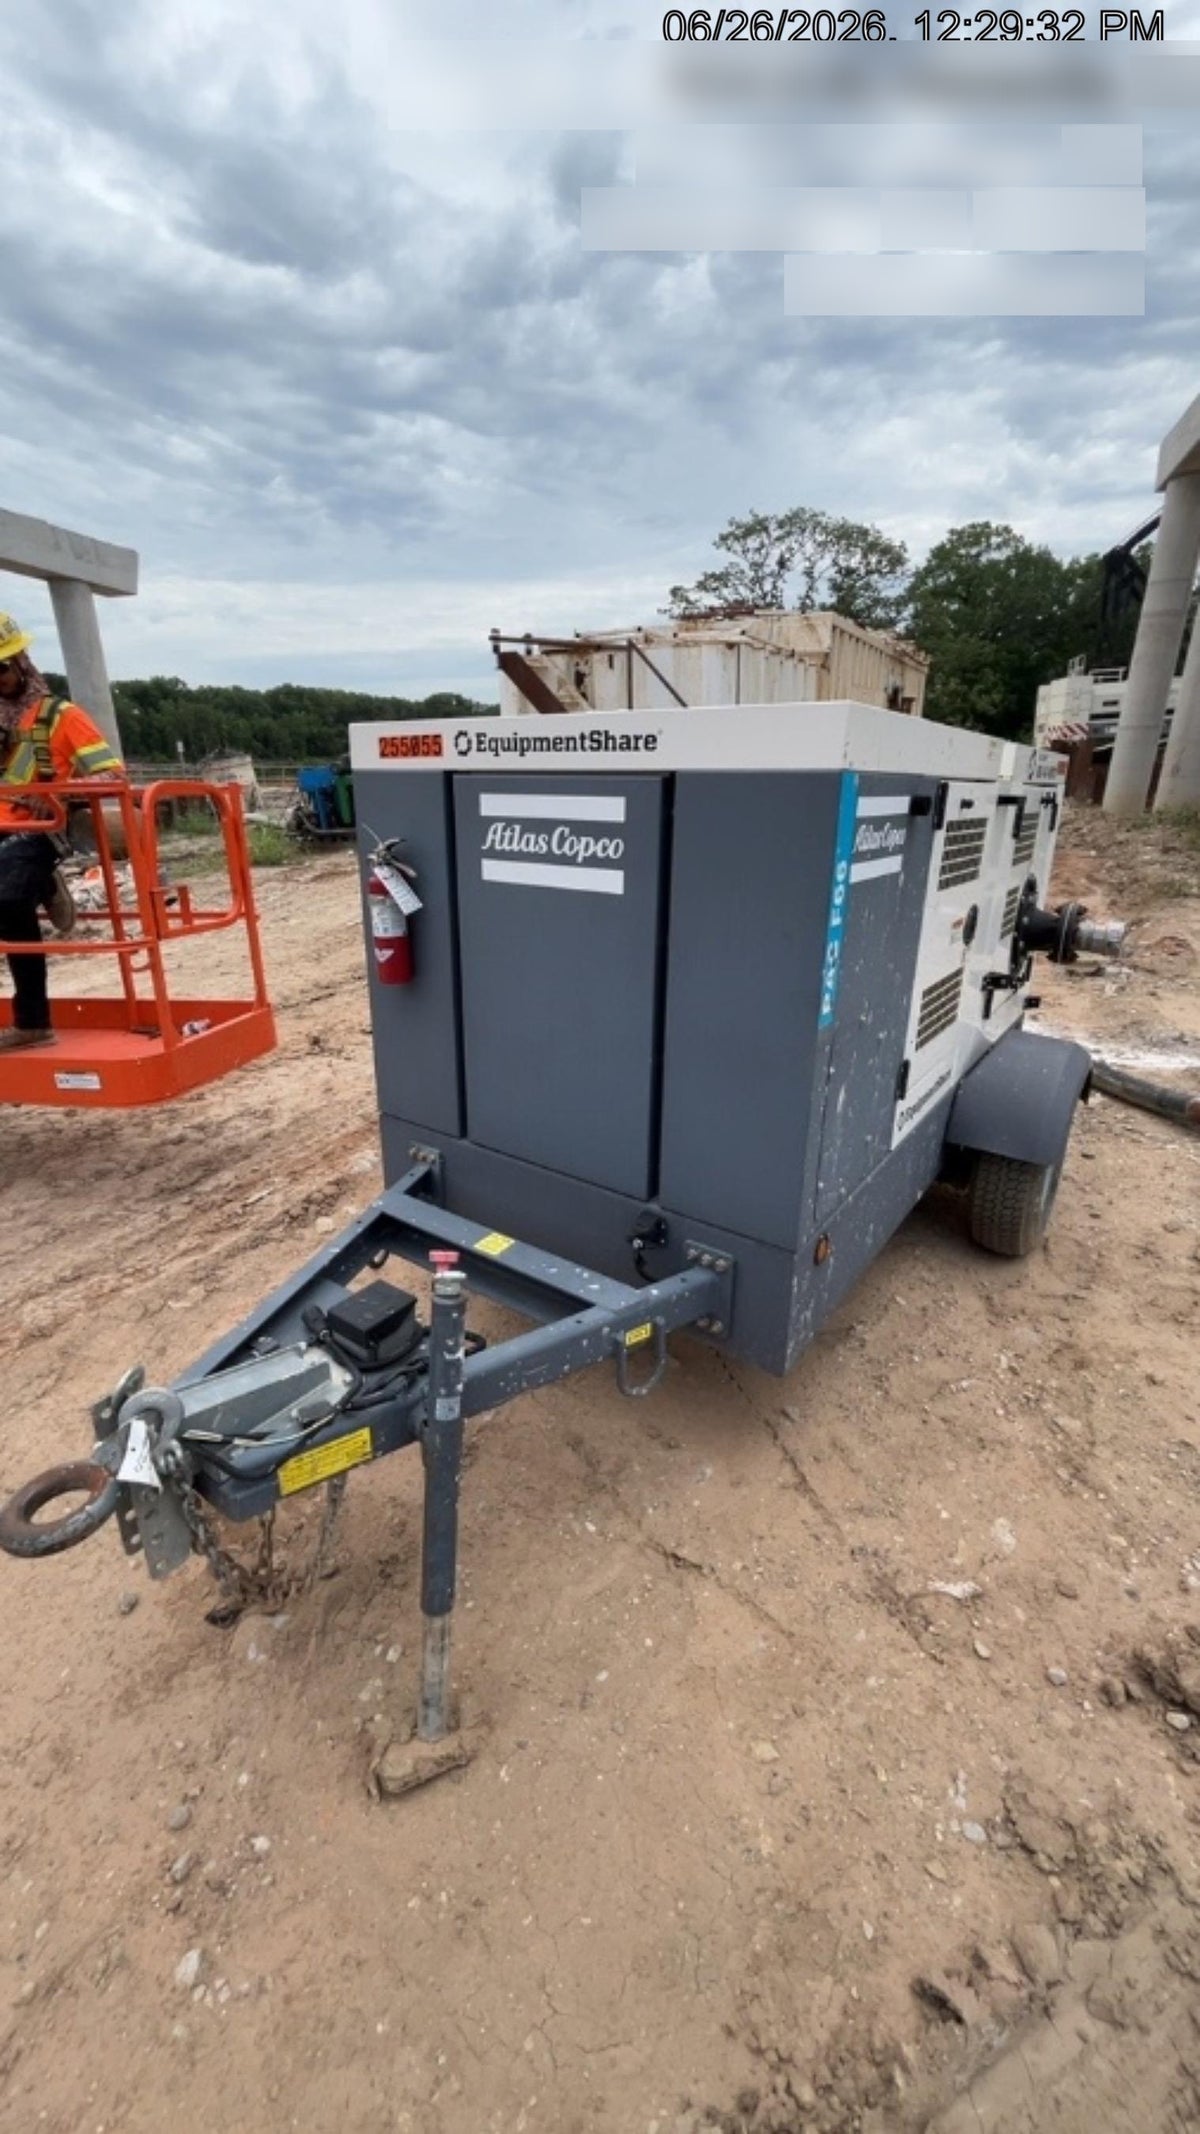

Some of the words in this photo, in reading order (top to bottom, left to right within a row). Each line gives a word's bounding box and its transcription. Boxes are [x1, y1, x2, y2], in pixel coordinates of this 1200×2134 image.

[475, 730, 659, 757] EquipmentShare
[481, 821, 549, 854] Atlas
[551, 825, 625, 864] Copco
[821, 938, 840, 1016] PAC
